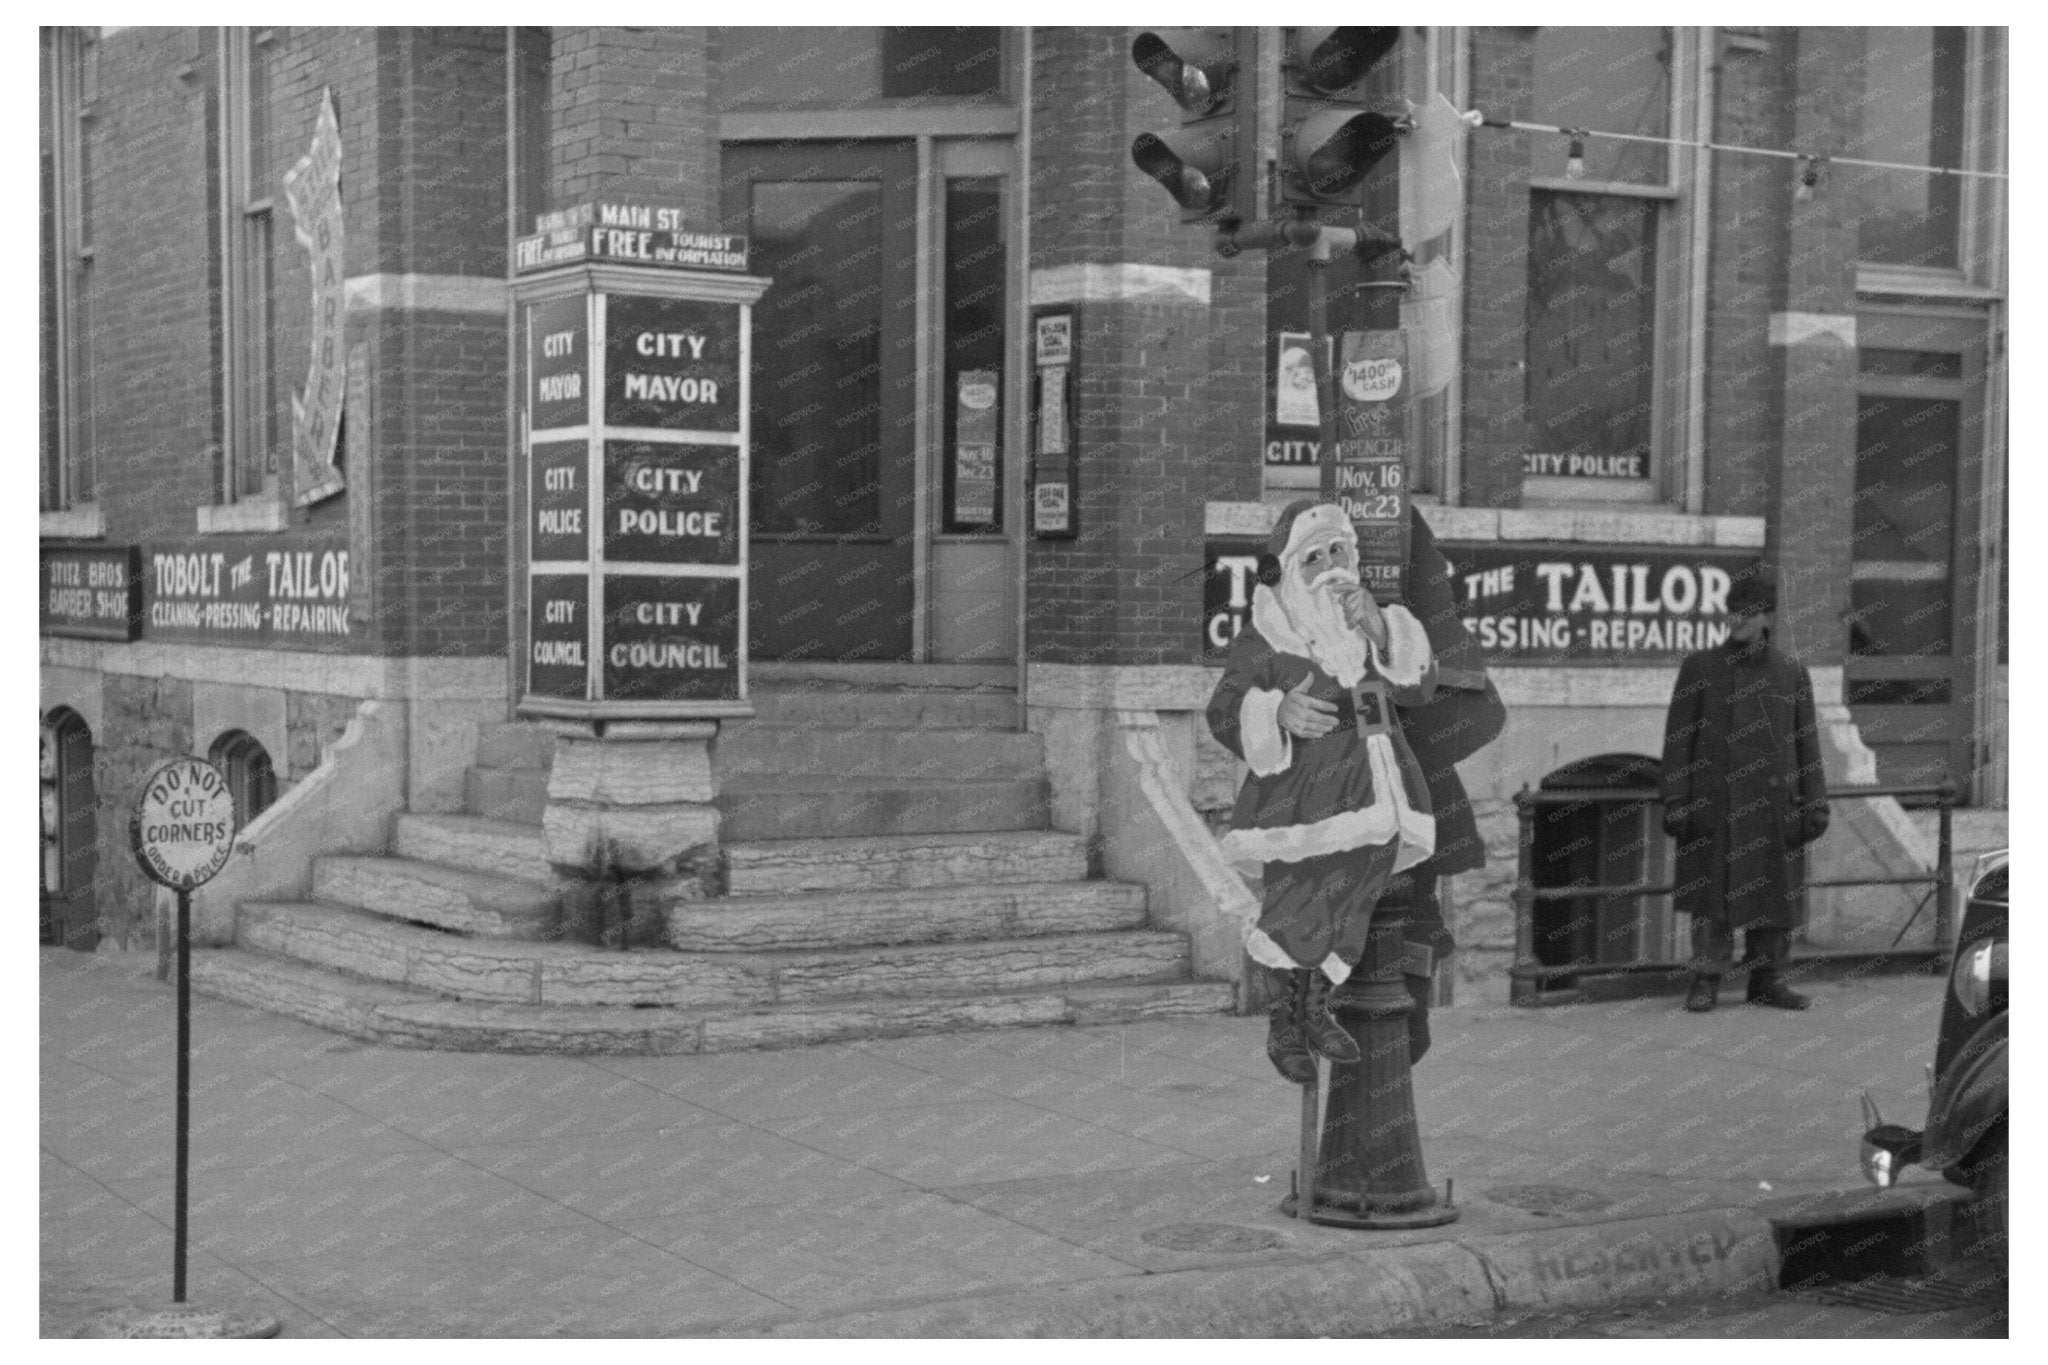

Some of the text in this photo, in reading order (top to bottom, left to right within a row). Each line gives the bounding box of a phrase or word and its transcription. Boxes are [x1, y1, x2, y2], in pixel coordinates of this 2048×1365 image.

[601, 204, 651, 228] MAIN
[593, 229, 652, 259] FREE
[672, 232, 732, 250] TOURIST
[656, 248, 747, 267] INFORMATION
[544, 331, 574, 357] CITY
[636, 332, 706, 359] CITY
[540, 373, 582, 401] MAYOR
[624, 373, 718, 403] MAYOR
[1363, 376, 1396, 391] CASH
[1267, 441, 1321, 462] CITY
[1341, 465, 1400, 488] Nov. 16
[1569, 455, 1641, 477] POLICE
[545, 467, 575, 491] CITY
[636, 468, 703, 493] CITY
[1341, 495, 1400, 518] Dec. 23
[539, 509, 582, 534] POLICE
[620, 508, 722, 537] POLICE
[153, 550, 349, 599] TOBOLT THE TAILOR
[1361, 566, 1400, 579] ISTER
[1464, 563, 1732, 614] THE TAILOR
[49, 588, 92, 616] BARBER
[546, 600, 576, 623] CITY
[636, 602, 702, 625] CITY
[1591, 619, 1732, 650] REPAIRIN
[534, 640, 585, 666] COUNCIL
[610, 643, 728, 669] COUNCIL
[152, 765, 226, 806] DO NOT
[170, 799, 206, 819] CUT
[147, 822, 226, 845] CORNERS
[193, 845, 228, 881] POLICE
